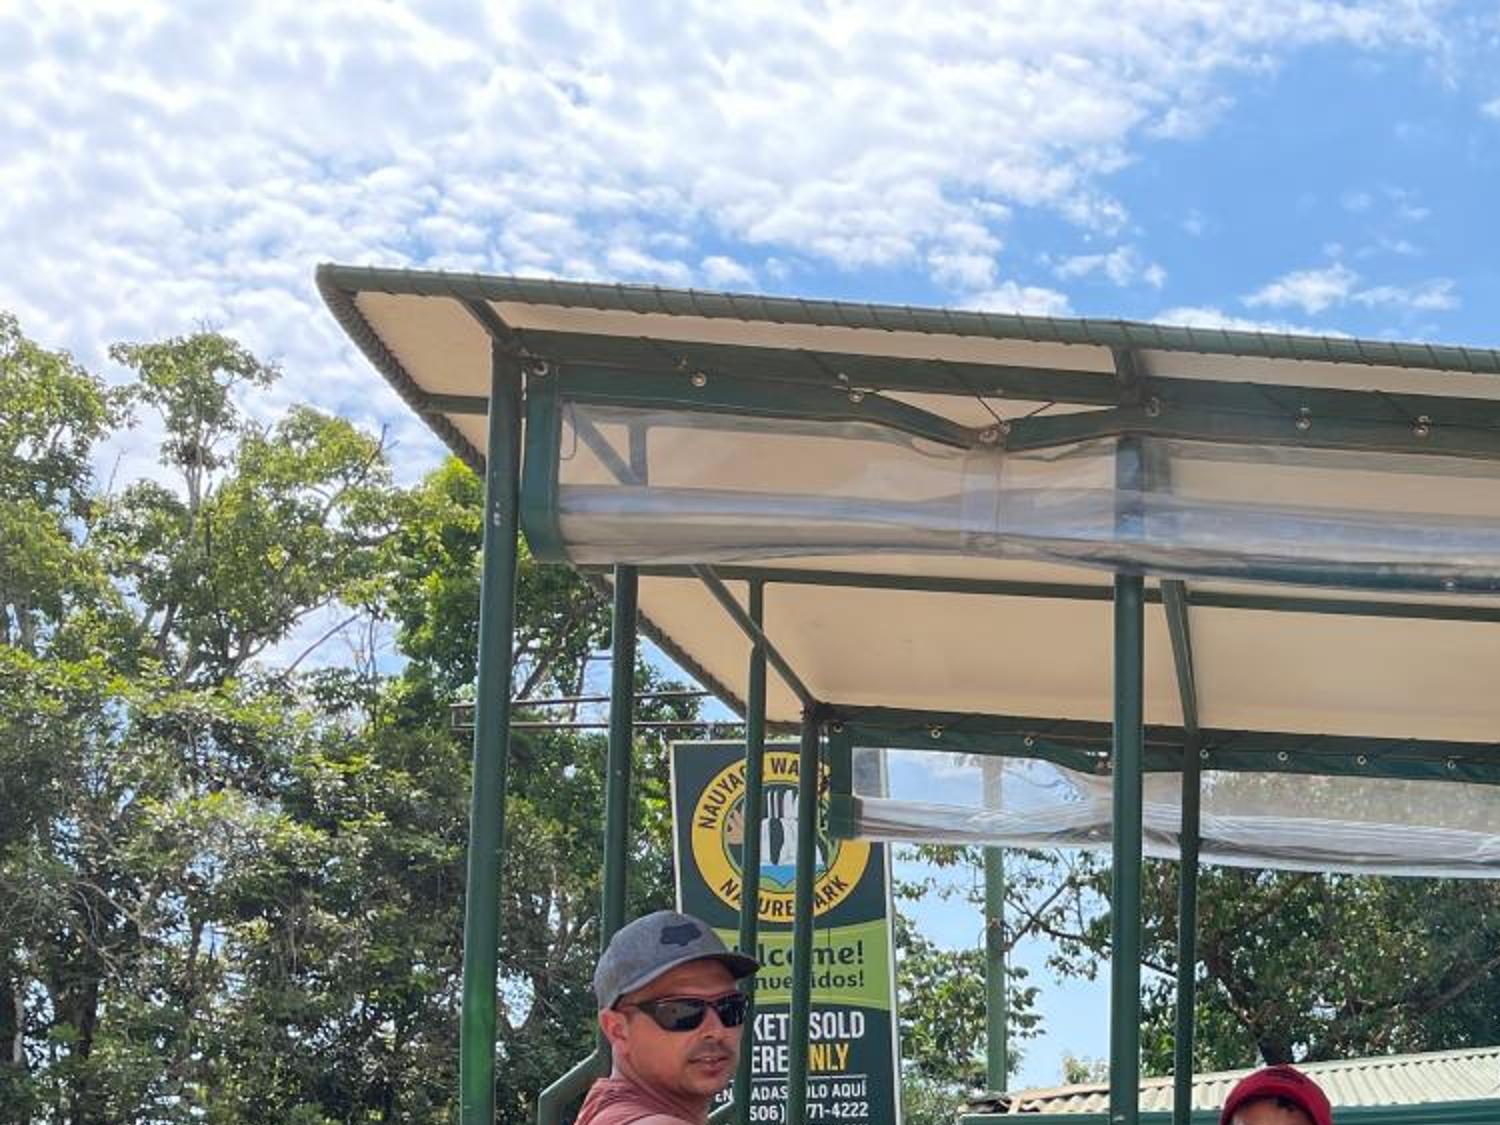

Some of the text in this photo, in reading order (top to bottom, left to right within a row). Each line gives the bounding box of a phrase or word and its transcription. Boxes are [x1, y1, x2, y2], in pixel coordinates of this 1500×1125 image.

[814, 875, 848, 908] ARK
[809, 1011, 865, 1039] SOLD
[751, 1043, 849, 1073] ERE NLY
[715, 1084, 788, 1104] ENADAS
[831, 1080, 866, 1099] AQUÍ
[749, 1102, 869, 1124] 506) 71-4222
